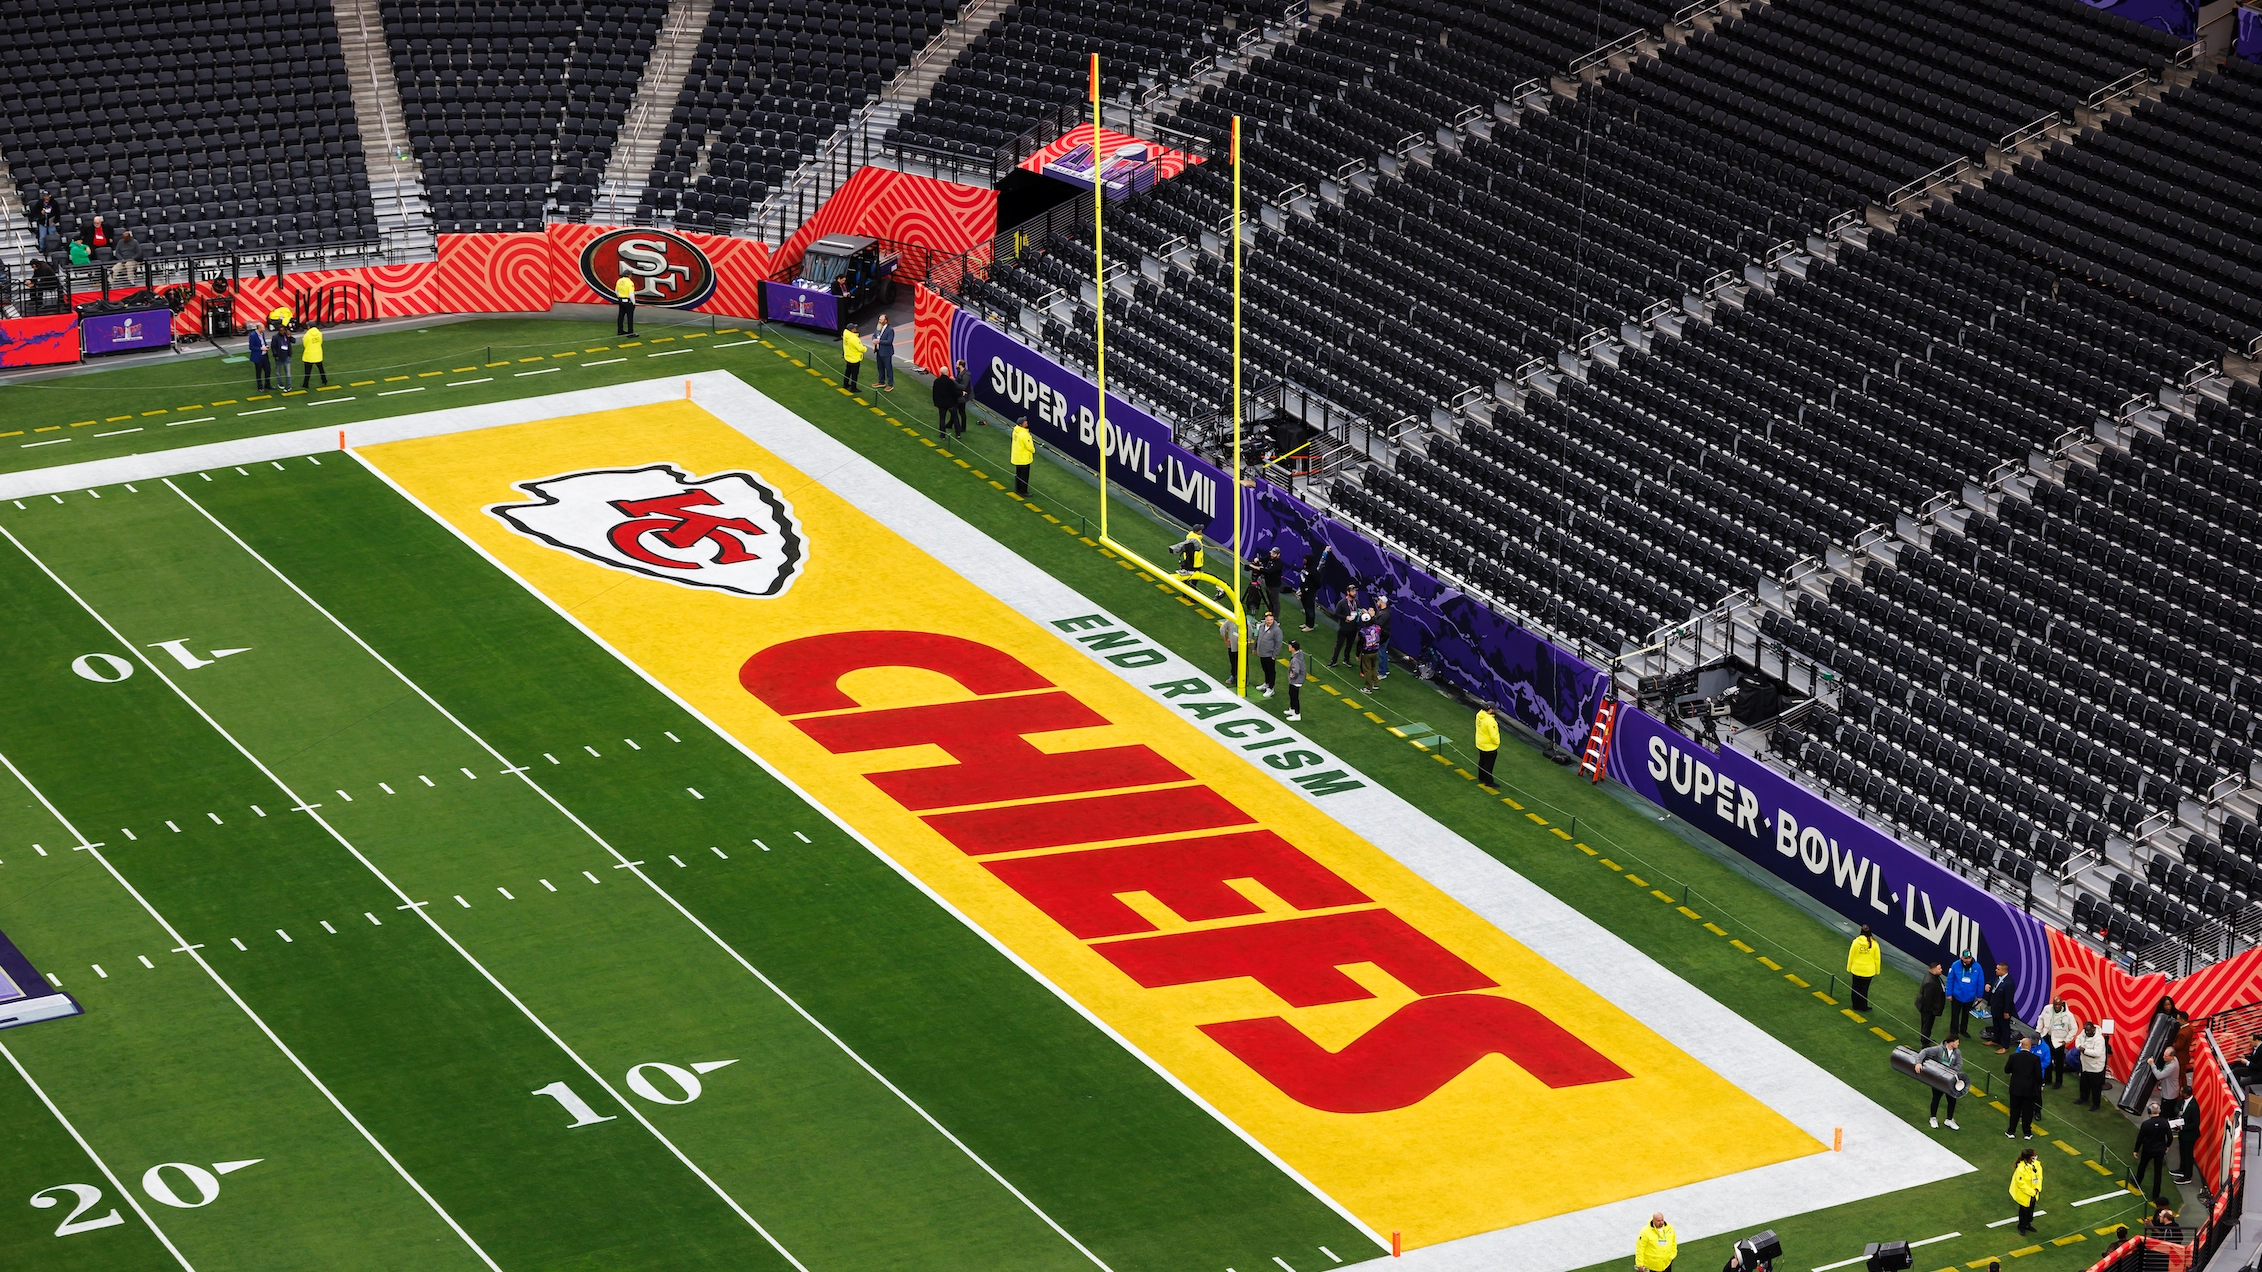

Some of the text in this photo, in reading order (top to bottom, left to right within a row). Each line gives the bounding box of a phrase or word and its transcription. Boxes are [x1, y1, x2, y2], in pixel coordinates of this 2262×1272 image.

[203, 270, 221, 280] 117
[617, 239, 690, 298] SF
[991, 356, 1216, 519] SUPER BOWL LVIII
[606, 488, 768, 569] KC
[1050, 614, 1367, 797] END RACISM
[739, 630, 1635, 1113] CHIEFS
[1647, 736, 1980, 962] SUPER BOWL LVIII
